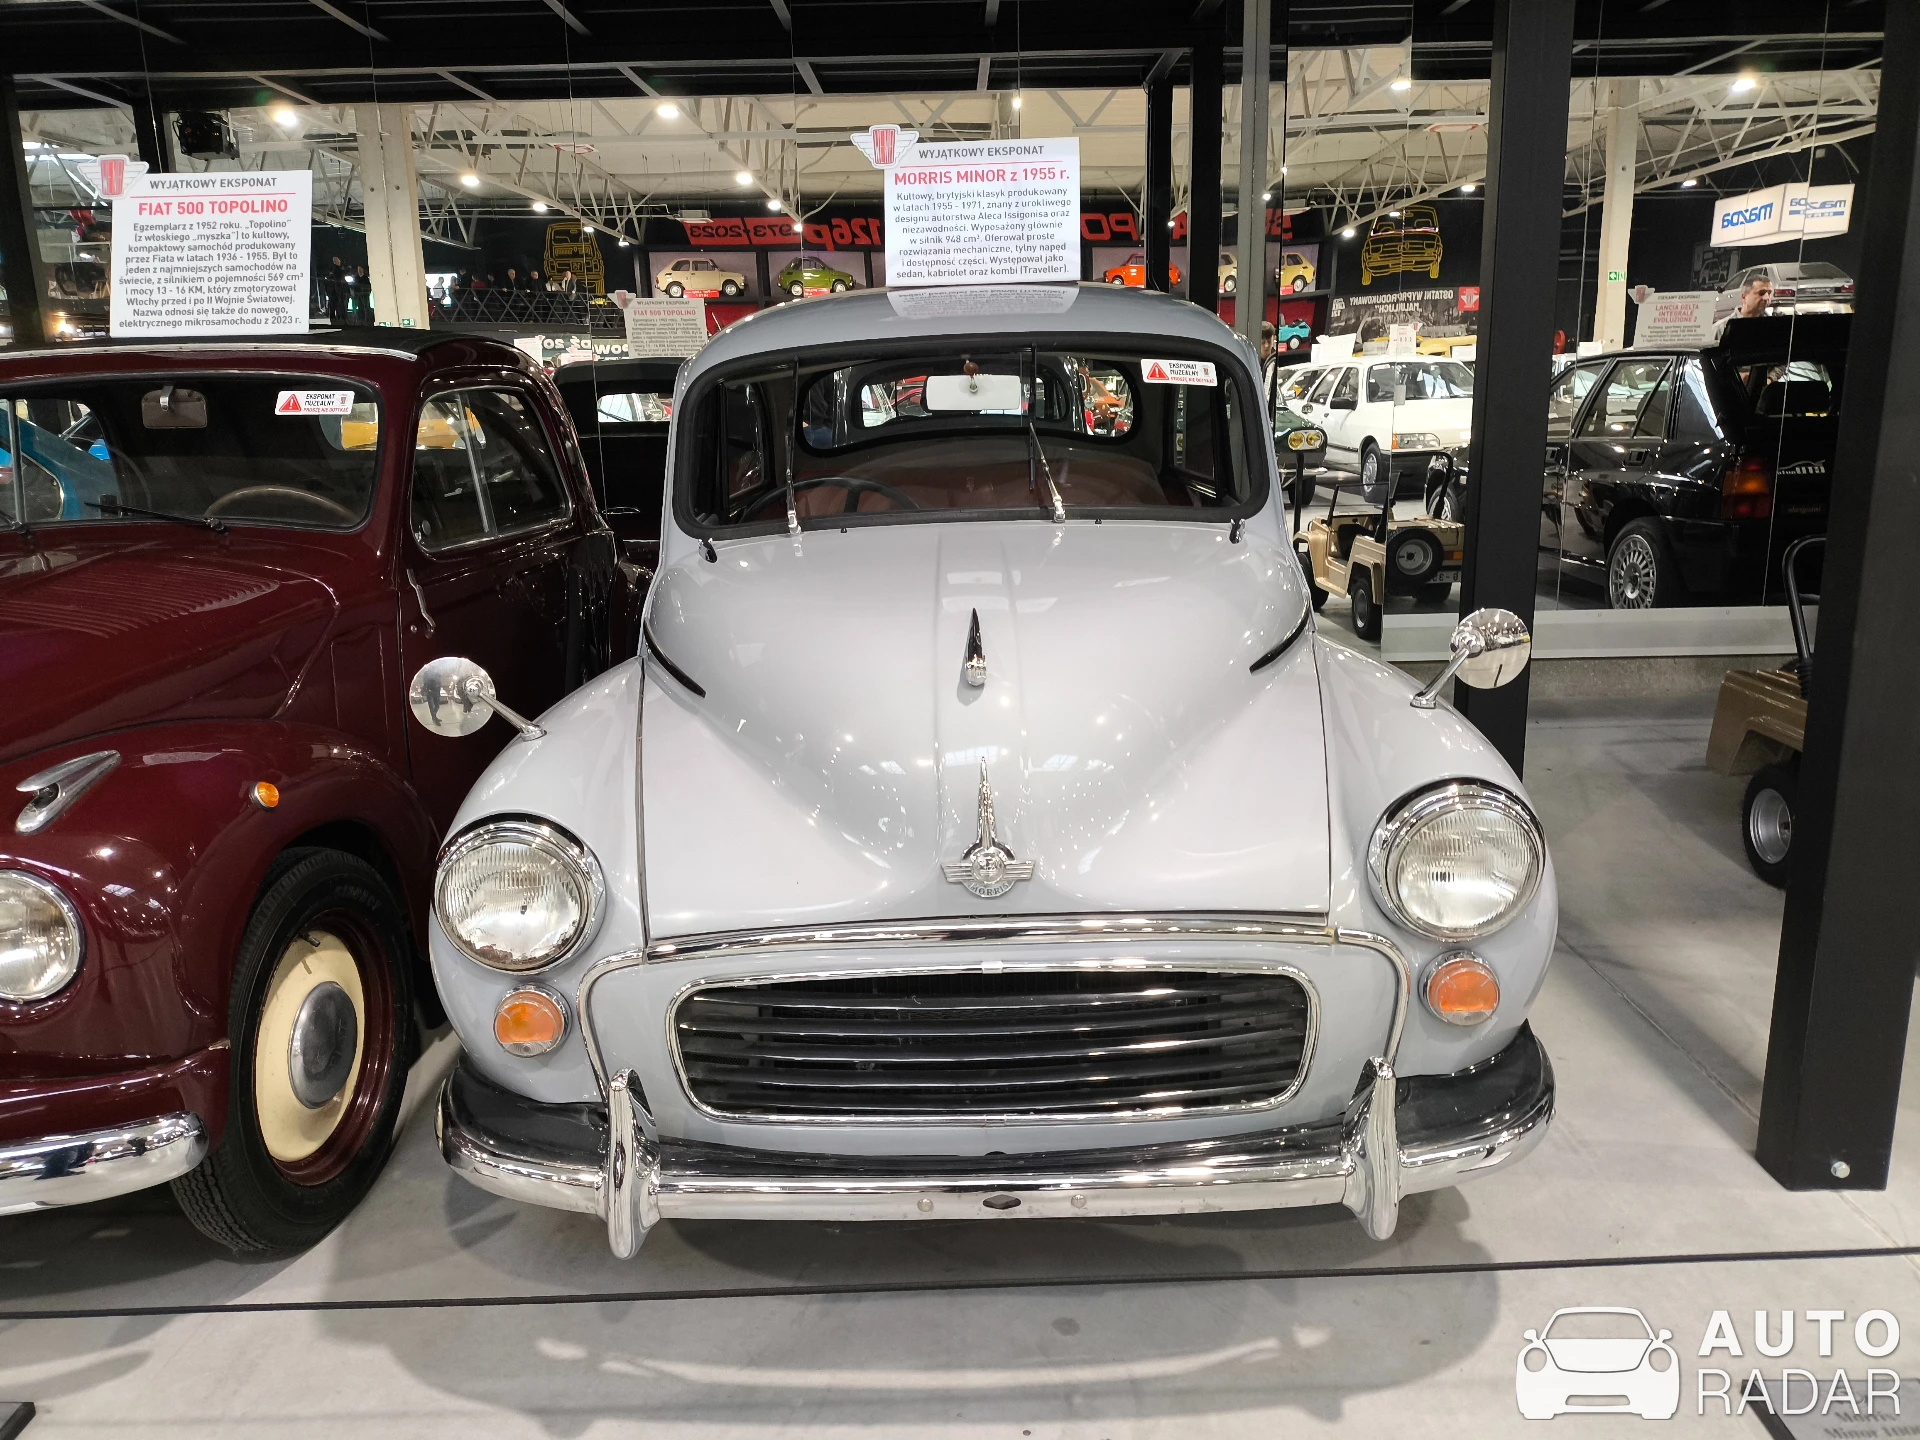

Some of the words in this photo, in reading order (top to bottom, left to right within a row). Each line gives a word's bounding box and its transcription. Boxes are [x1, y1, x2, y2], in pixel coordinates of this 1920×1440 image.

[918, 147, 985, 160] WYJĄTKOWY
[987, 145, 1044, 156] EKSPONAT
[894, 170, 953, 185] MORRIS
[956, 168, 1006, 183] MINOR
[1010, 172, 1018, 181] z
[1022, 167, 1056, 181] 1955
[1060, 170, 1069, 180] r.
[149, 179, 217, 191] WYJĄTKOWY
[220, 177, 277, 188] EKSPONAT
[897, 191, 934, 202] Kultowy,
[936, 190, 975, 201] brytyjski
[976, 189, 1005, 200] klasyk
[1007, 187, 1068, 199] produkowany
[138, 202, 173, 215] FIAT
[177, 201, 204, 215] 500
[208, 199, 288, 214] TOPOLINO
[903, 202, 930, 211] latach
[932, 201, 953, 210] 1955
[962, 201, 984, 210] 1971,
[987, 202, 1013, 210] znany
[1021, 198, 1071, 209] urokliwego
[895, 214, 929, 224] designu
[931, 212, 976, 221] autorstwa
[978, 211, 1002, 220] Aleca
[1004, 210, 1049, 221] Issigonisa
[133, 222, 187, 233] Egzemplarz
[196, 221, 217, 230] 1952
[219, 221, 242, 229] roku.
[902, 223, 968, 233] niezawodności.
[970, 222, 1026, 233] Wyposażony
[1027, 221, 1063, 231] głównie
[144, 233, 190, 244] włoskiego
[241, 231, 250, 239] to
[252, 230, 290, 241] kultowy,
[919, 235, 943, 244] silnik
[945, 235, 961, 243] 948
[984, 233, 1025, 242] Oferował
[1026, 232, 1055, 243] proste
[128, 243, 186, 254] kompaktowy
[187, 242, 233, 251] samochód
[235, 241, 296, 252] produkowany
[899, 246, 951, 258] rozwiązania
[953, 244, 1013, 255] mechaniczne,
[1015, 244, 1037, 254] tylny
[1039, 243, 1066, 253] napęd
[125, 257, 150, 265] przez
[152, 254, 175, 263] Fiata
[186, 253, 214, 262] latach
[217, 253, 238, 261] 1936
[246, 252, 270, 260] 1955.
[272, 252, 287, 262] Był
[289, 251, 298, 259] to
[906, 257, 955, 269] dostępność
[958, 256, 987, 267] części.
[989, 255, 1043, 266] Występował
[1045, 254, 1064, 264] jako
[126, 265, 151, 276] jeden
[159, 264, 223, 275] najmniejszych
[225, 262, 284, 271] samochodów
[896, 269, 925, 279] sedan,
[927, 268, 967, 277] kabriolet
[990, 266, 1018, 275] kombi
[119, 276, 155, 286] świecie,
[163, 275, 205, 284] silnikiem
[214, 273, 266, 284] pojemności
[267, 273, 284, 281] 569
[130, 289, 154, 297] mocy
[157, 286, 167, 295] 13
[176, 286, 186, 294] 16
[188, 286, 205, 295] KM,
[207, 285, 232, 295] który
[233, 283, 296, 295] zmotoryzował
[126, 297, 159, 308] Włochy
[161, 296, 187, 307] przed
[193, 298, 205, 306] po
[207, 296, 213, 304] II
[214, 295, 245, 306] Wojnie
[247, 292, 295, 305] Światowej.
[133, 308, 163, 317] Nazwa
[164, 307, 194, 316] odnosi
[196, 307, 210, 317] się
[211, 306, 236, 315] także
[237, 306, 249, 314] do
[251, 307, 288, 316] nowego,
[119, 318, 183, 330] elektrycznego
[184, 316, 262, 326] mikrosamochodu
[271, 316, 293, 324] 2023
[970, 882, 1008, 896] MORRIS
